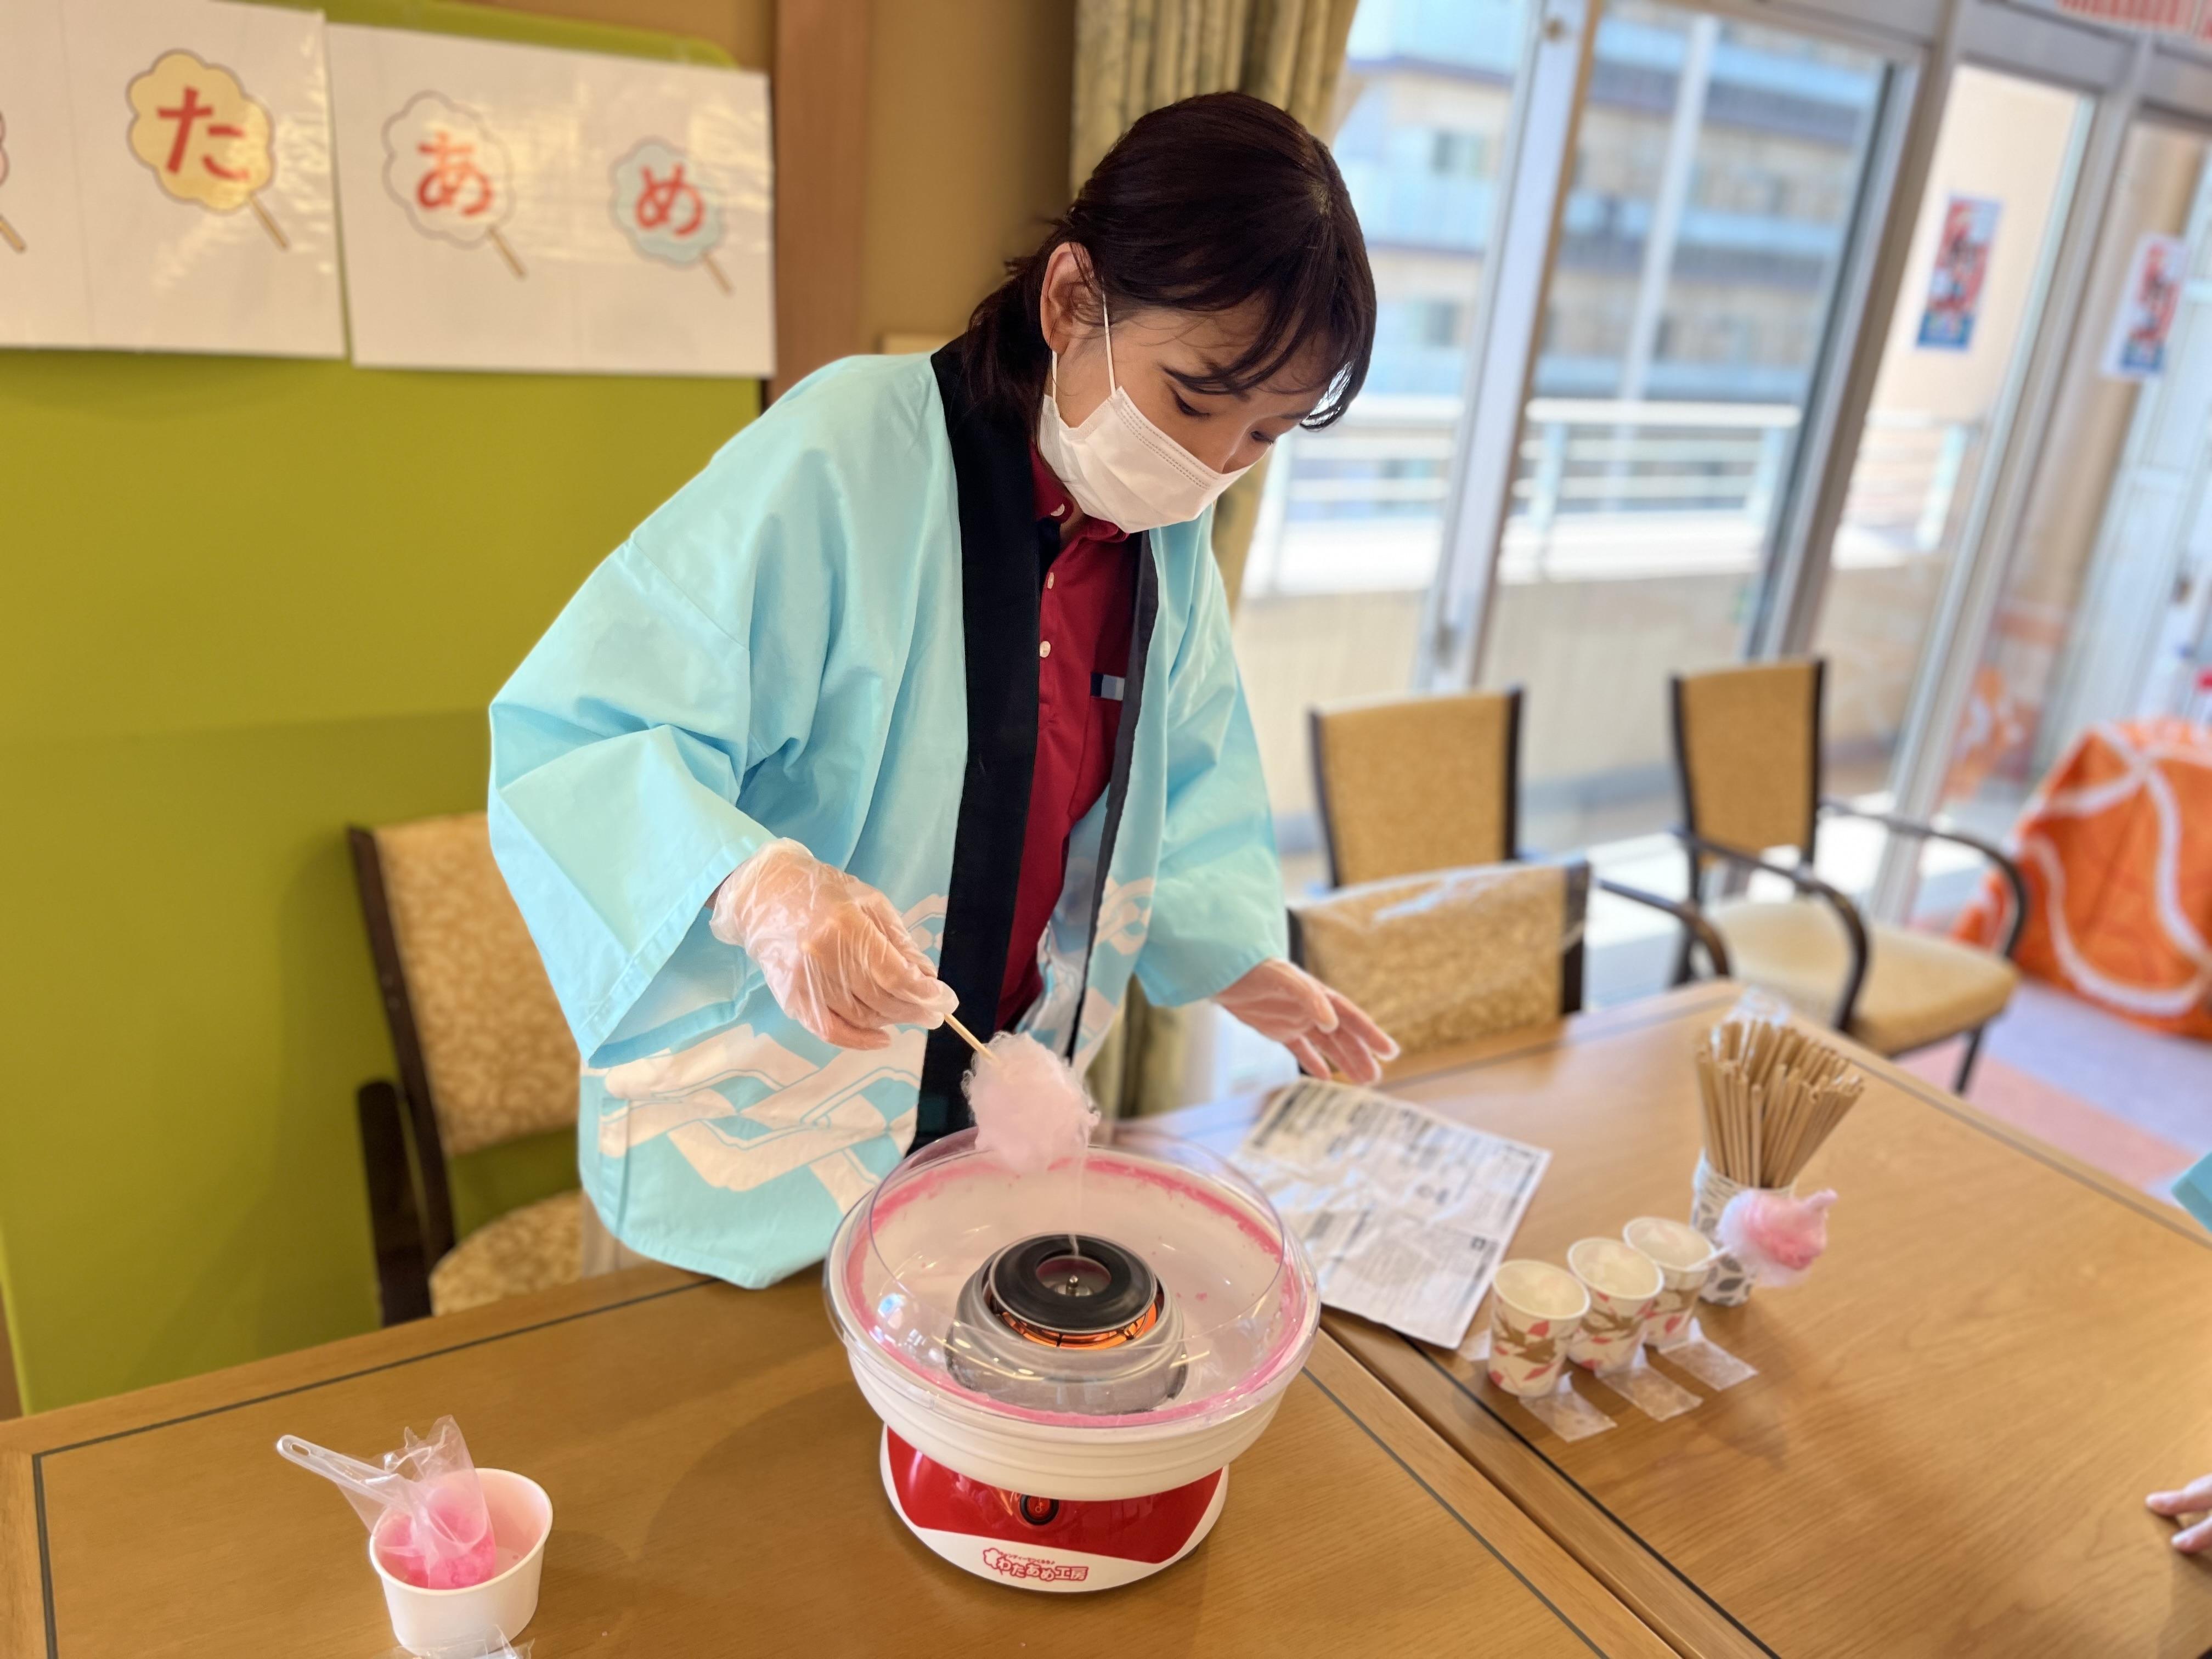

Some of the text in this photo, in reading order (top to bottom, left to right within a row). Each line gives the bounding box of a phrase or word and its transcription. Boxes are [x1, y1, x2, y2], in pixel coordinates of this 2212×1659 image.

[156, 86, 704, 238] た あ め
[997, 1558, 1088, 1581] わたあめ工房
